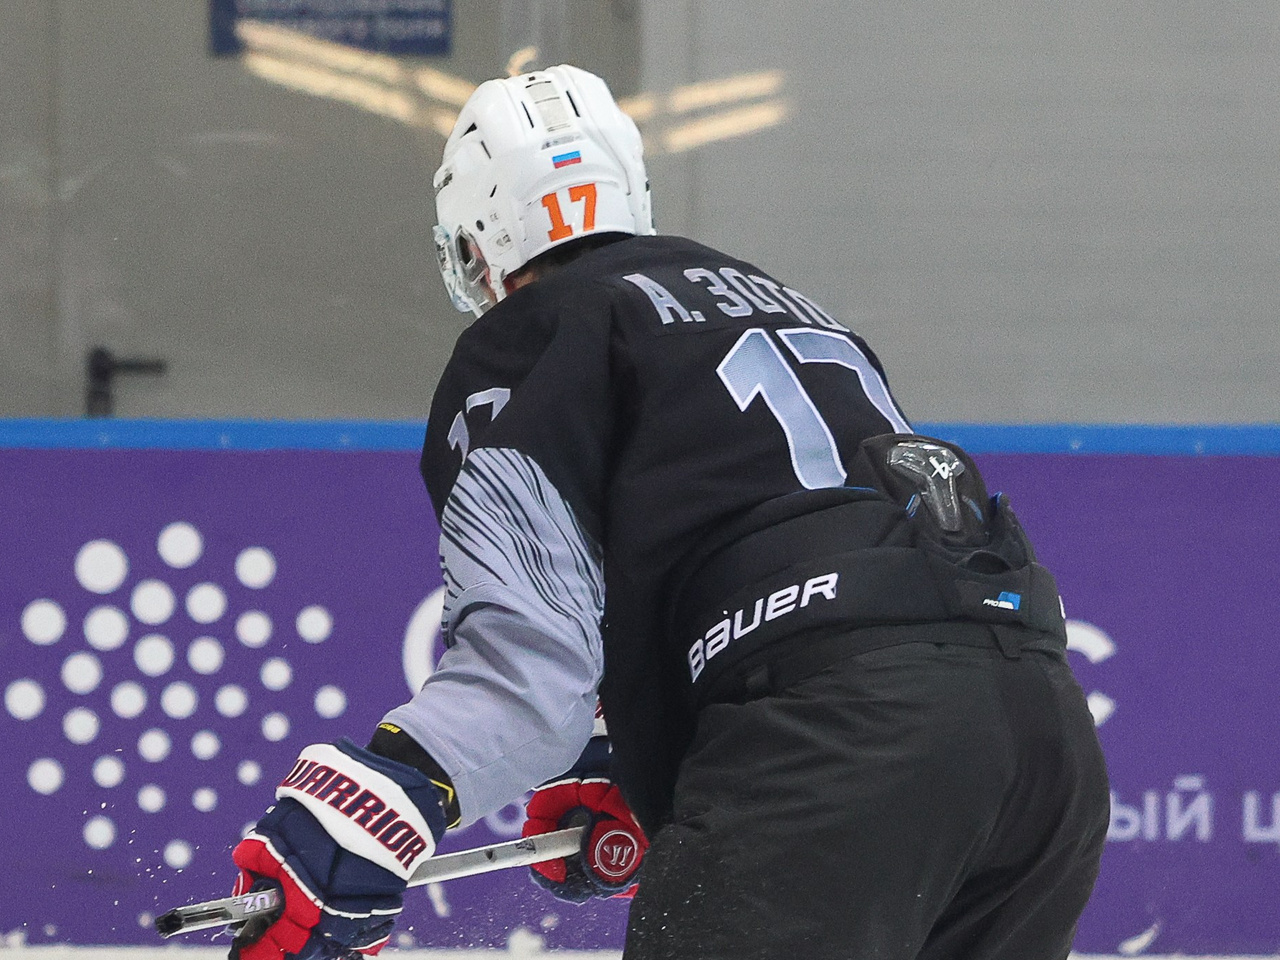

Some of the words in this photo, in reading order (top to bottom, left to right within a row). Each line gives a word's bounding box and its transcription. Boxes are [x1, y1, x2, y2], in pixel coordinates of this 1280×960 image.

[541, 182, 597, 242] 17
[716, 327, 914, 490] 17
[688, 572, 839, 684] BAUER
